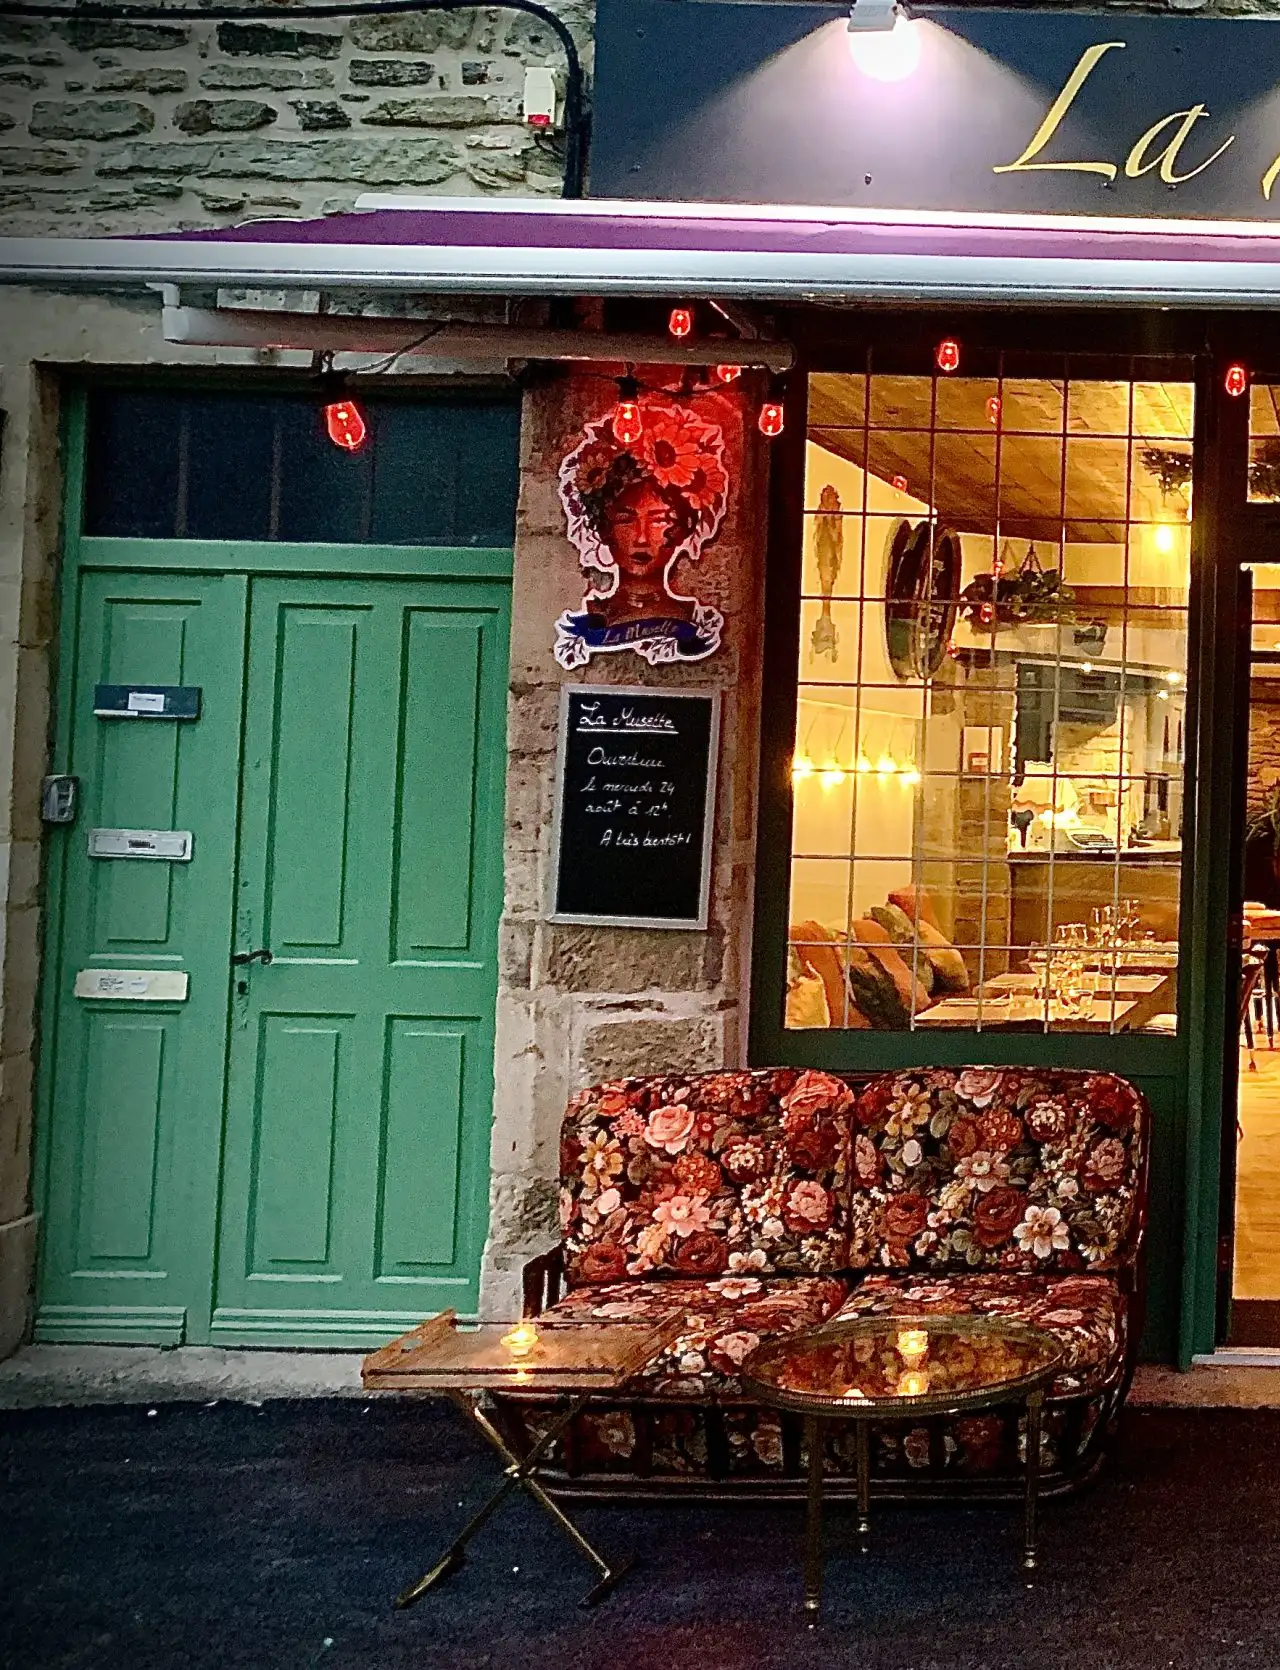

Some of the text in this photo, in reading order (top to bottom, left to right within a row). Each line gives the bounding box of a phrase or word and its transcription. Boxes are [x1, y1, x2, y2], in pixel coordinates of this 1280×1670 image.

[992, 41, 1236, 186] La
[580, 701, 675, 729] La Musette
[659, 781, 675, 796] 24
